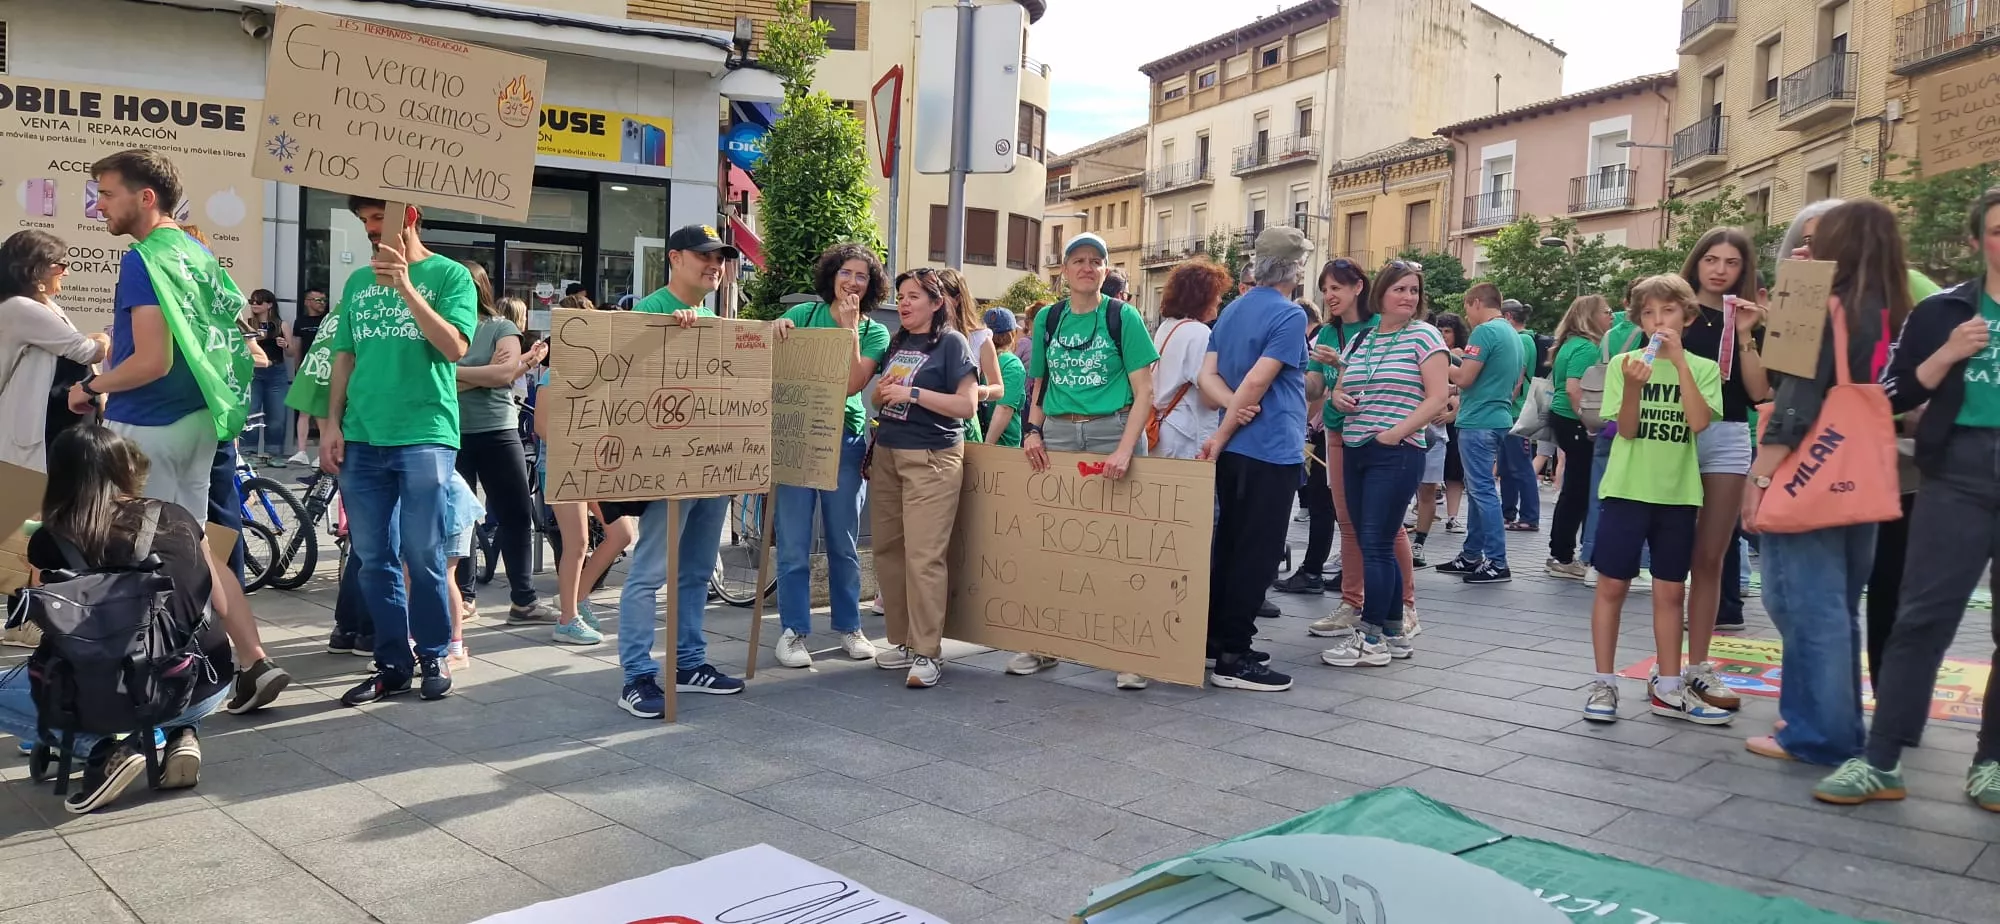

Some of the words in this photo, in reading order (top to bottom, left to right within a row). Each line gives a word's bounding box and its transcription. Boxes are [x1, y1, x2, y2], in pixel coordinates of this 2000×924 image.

[336, 19, 359, 31] IES
[364, 23, 412, 40] HERMANOS
[284, 23, 341, 76] En
[364, 55, 465, 99] verano
[20, 117, 70, 131] VENTA
[87, 122, 177, 141] REPARACIÓN
[113, 94, 246, 132] HOUSE
[334, 84, 386, 114] nos
[400, 98, 503, 143] asamos,
[539, 109, 605, 136] USE
[6, 131, 37, 140] móviles
[47, 135, 86, 144] portátiles
[100, 139, 124, 148] Venta
[191, 147, 221, 155] móviles
[223, 148, 246, 157] libres
[293, 110, 321, 131] en
[347, 119, 464, 158] invierno
[303, 147, 360, 181] nos
[382, 154, 511, 202] CHELAMOS
[19, 219, 54, 229] Carcasas
[213, 233, 240, 242] Cables
[55, 294, 86, 302] Móviles
[356, 310, 371, 322] DE
[566, 394, 647, 437] TENGO
[651, 394, 687, 424] 186
[694, 396, 769, 420] ALUMNOS
[571, 441, 584, 466] Y
[632, 445, 643, 461] A
[652, 442, 671, 458] LA
[743, 437, 766, 456] PARA
[1784, 427, 1846, 498] MILAN
[555, 469, 665, 500] ATENDER
[676, 470, 688, 489] A
[1026, 471, 1191, 523] CONCIERTE
[1829, 480, 1855, 493] 430
[994, 511, 1022, 538] LA
[1037, 512, 1179, 566] ROSALÍA
[980, 554, 1018, 584] NO
[1059, 569, 1096, 597] LA
[984, 597, 1156, 649] CONSEJERÍA
